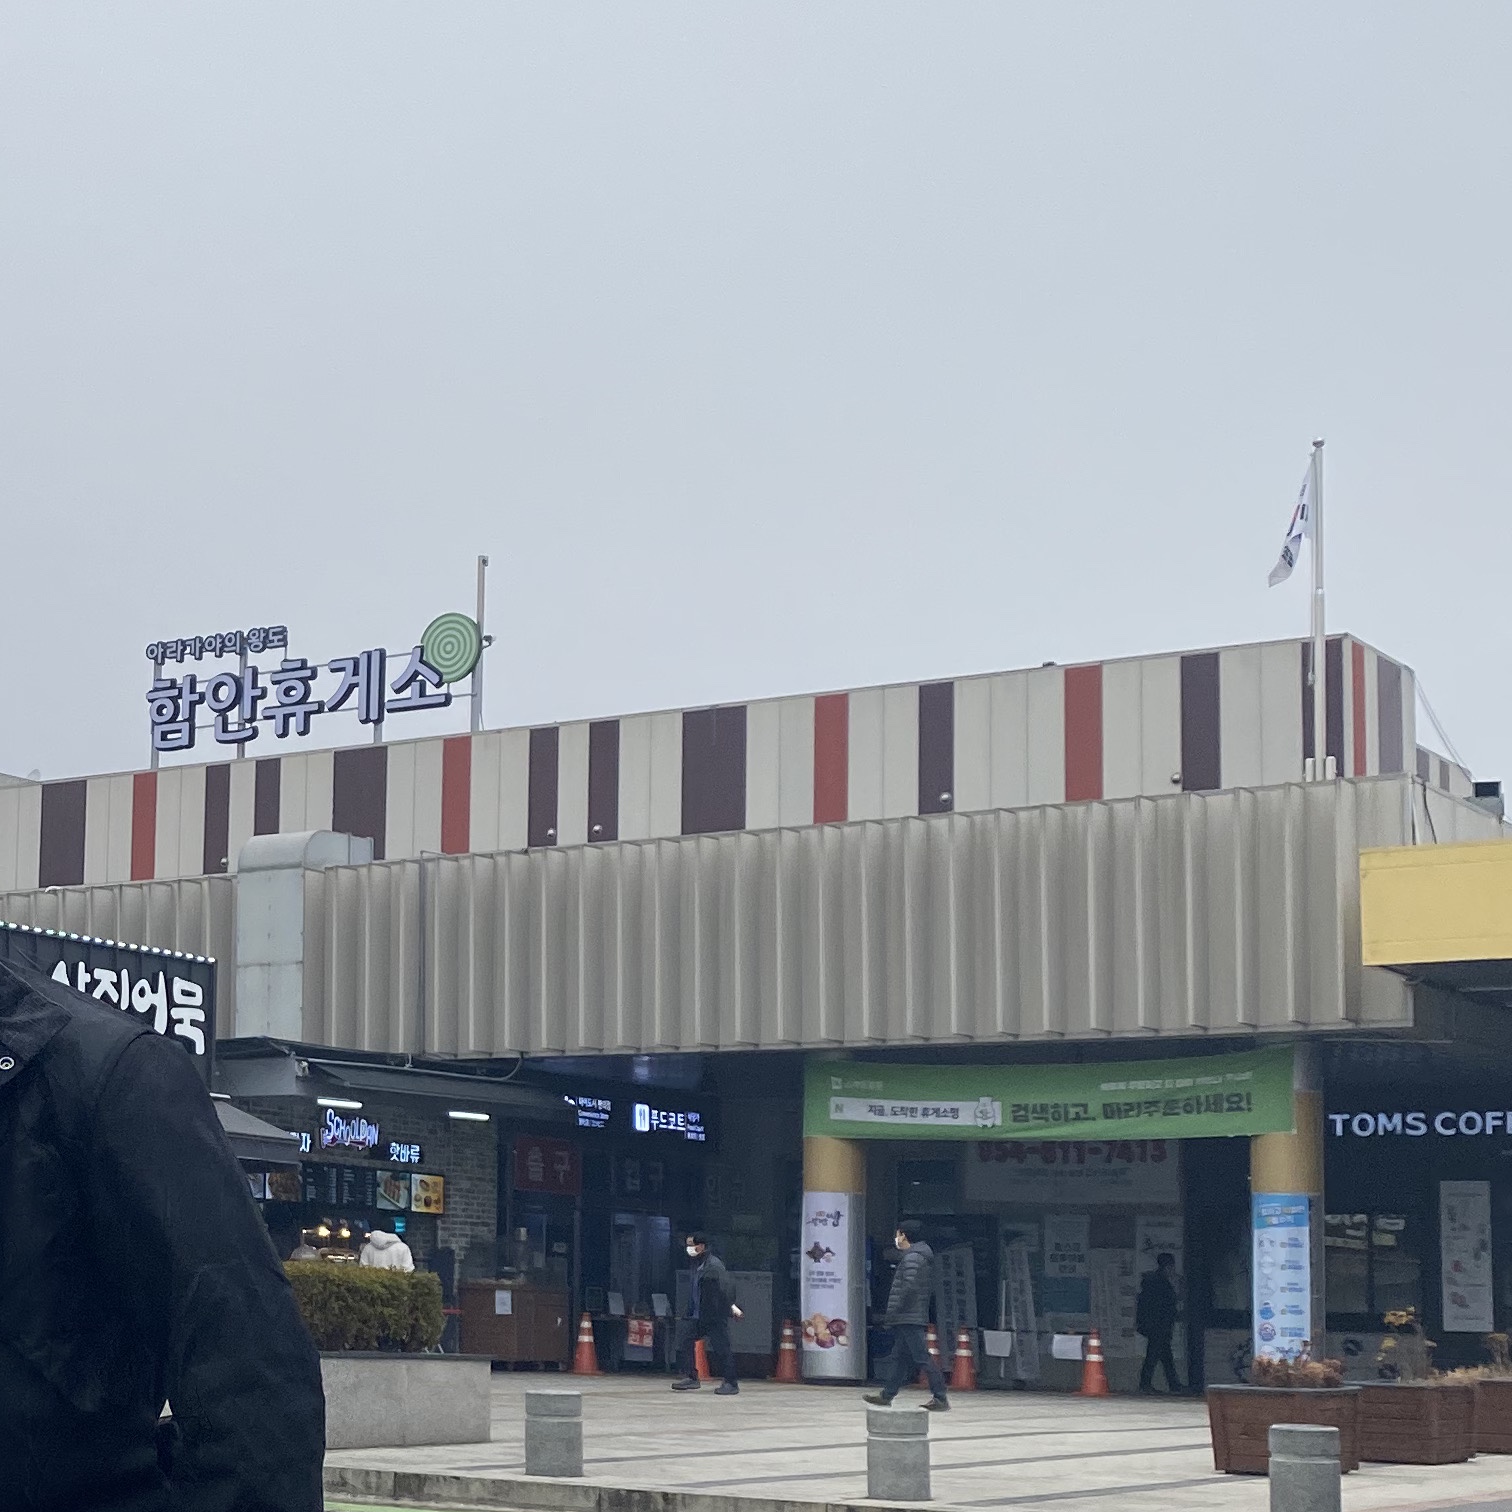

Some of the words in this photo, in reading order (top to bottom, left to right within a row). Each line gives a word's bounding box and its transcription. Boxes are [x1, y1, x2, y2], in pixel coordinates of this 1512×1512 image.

[146, 630, 243, 664] 아라가야의
[247, 626, 288, 653] 왕도
[146, 645, 452, 751] 함안휴게소
[651, 1109, 685, 1131] 푸드코트
[1329, 1111, 1428, 1137] TOMS
[390, 1142, 420, 1163] 핫바류
